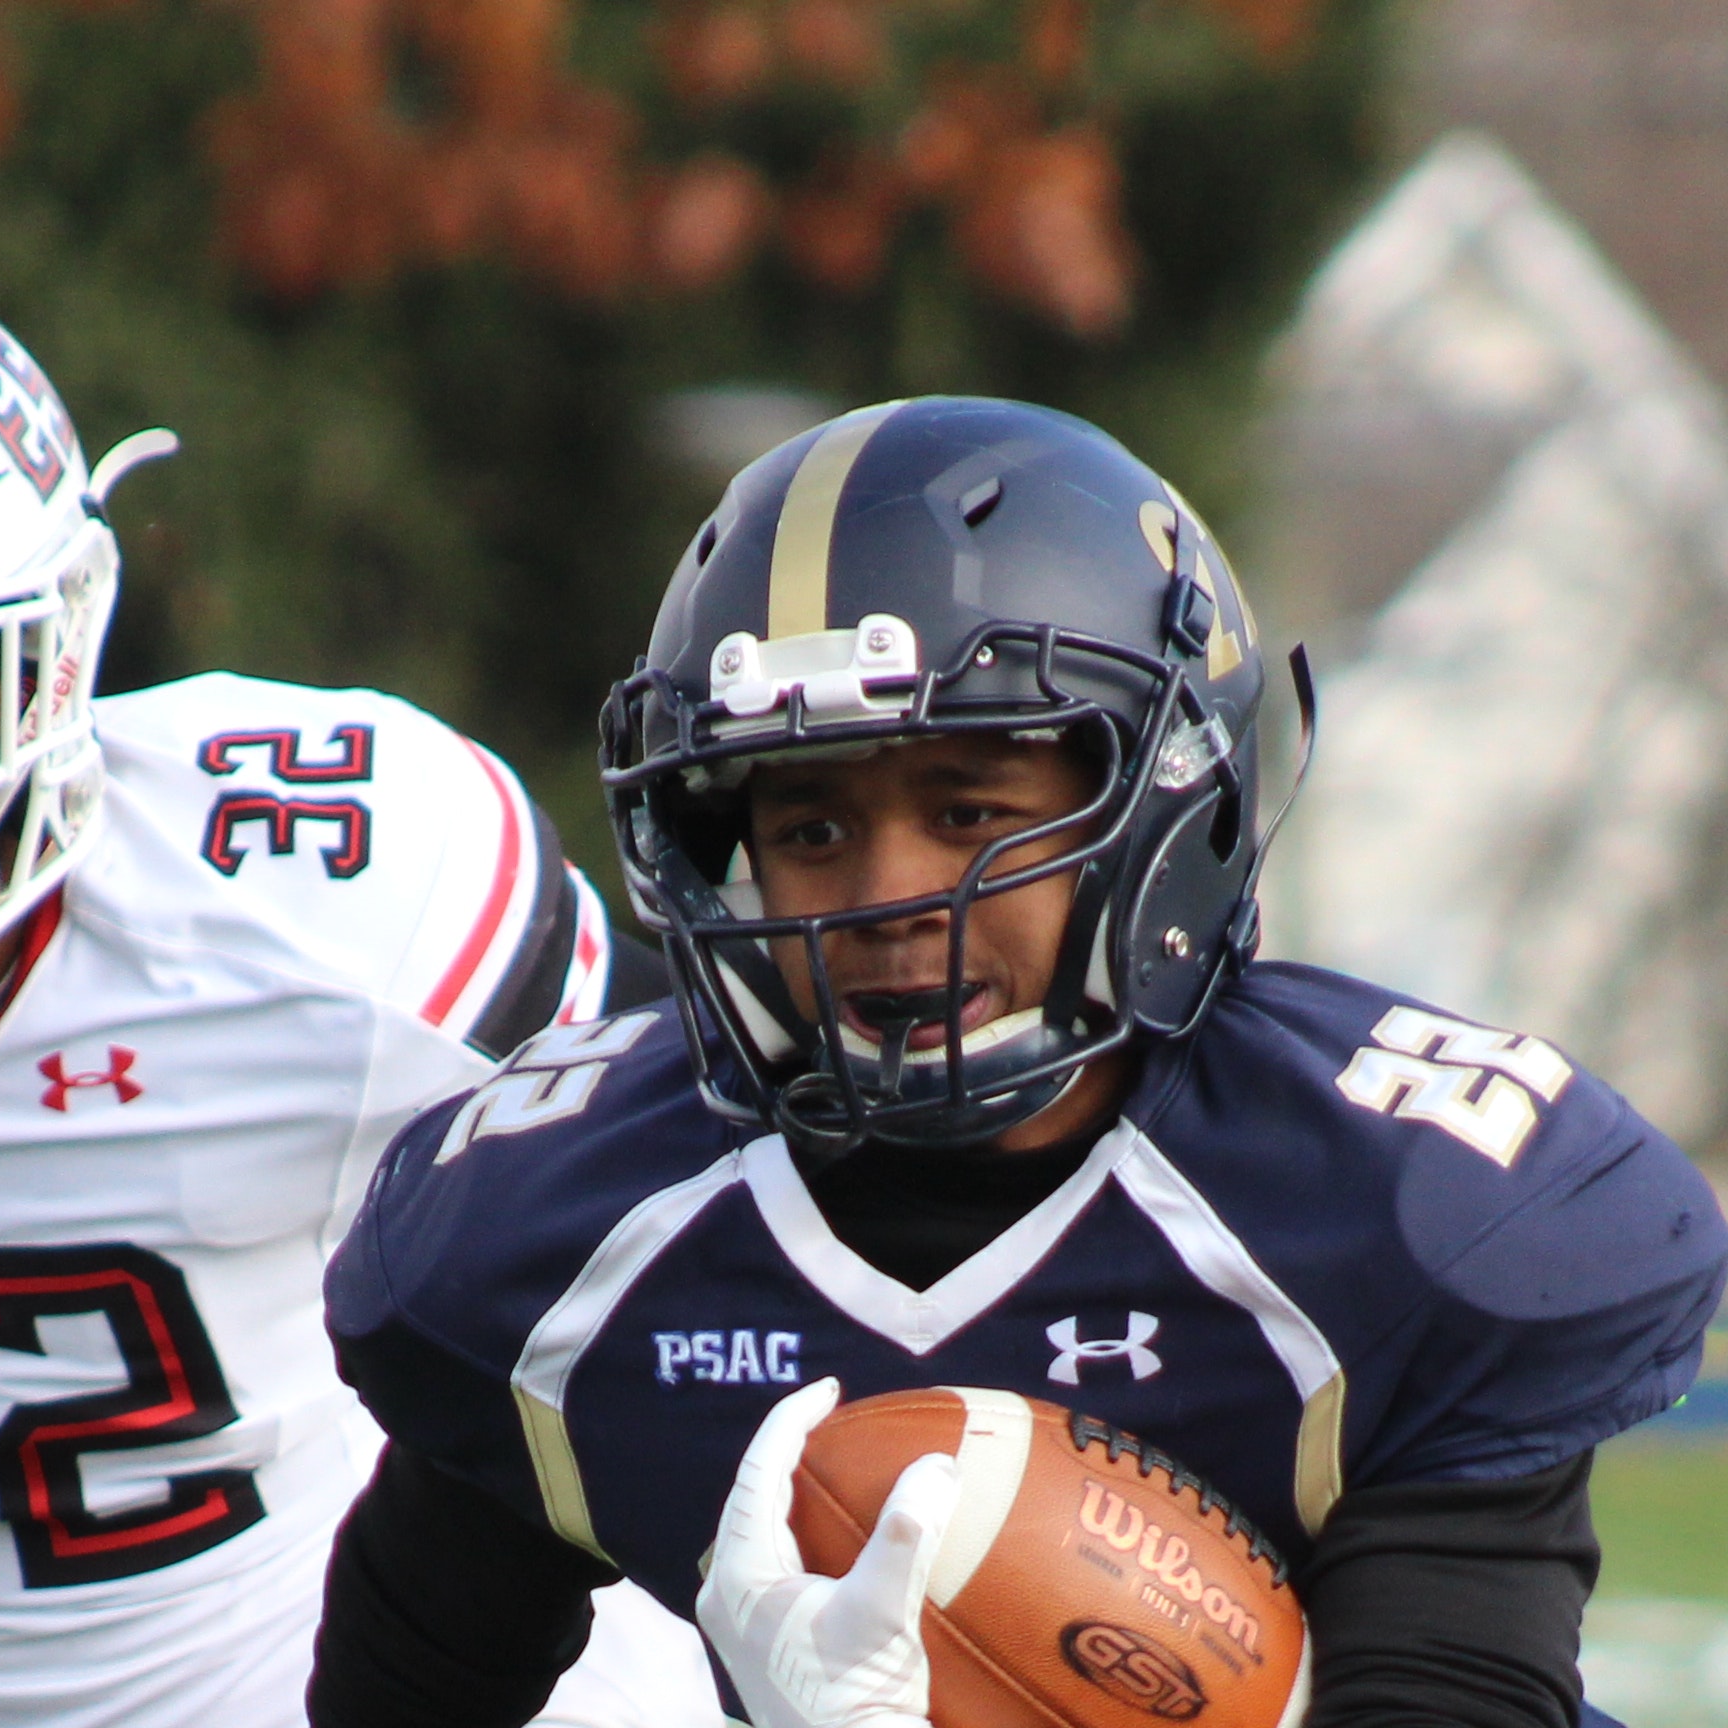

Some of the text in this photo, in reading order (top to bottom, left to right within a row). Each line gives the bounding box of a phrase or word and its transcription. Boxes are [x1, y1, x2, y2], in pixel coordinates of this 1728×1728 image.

[197, 723, 375, 880] 32
[432, 1010, 663, 1166] 22
[1333, 1004, 1575, 1169] 22
[652, 1328, 803, 1387] PSAC
[1079, 1479, 1260, 1656] Wilson
[1075, 1624, 1205, 1715] GST
